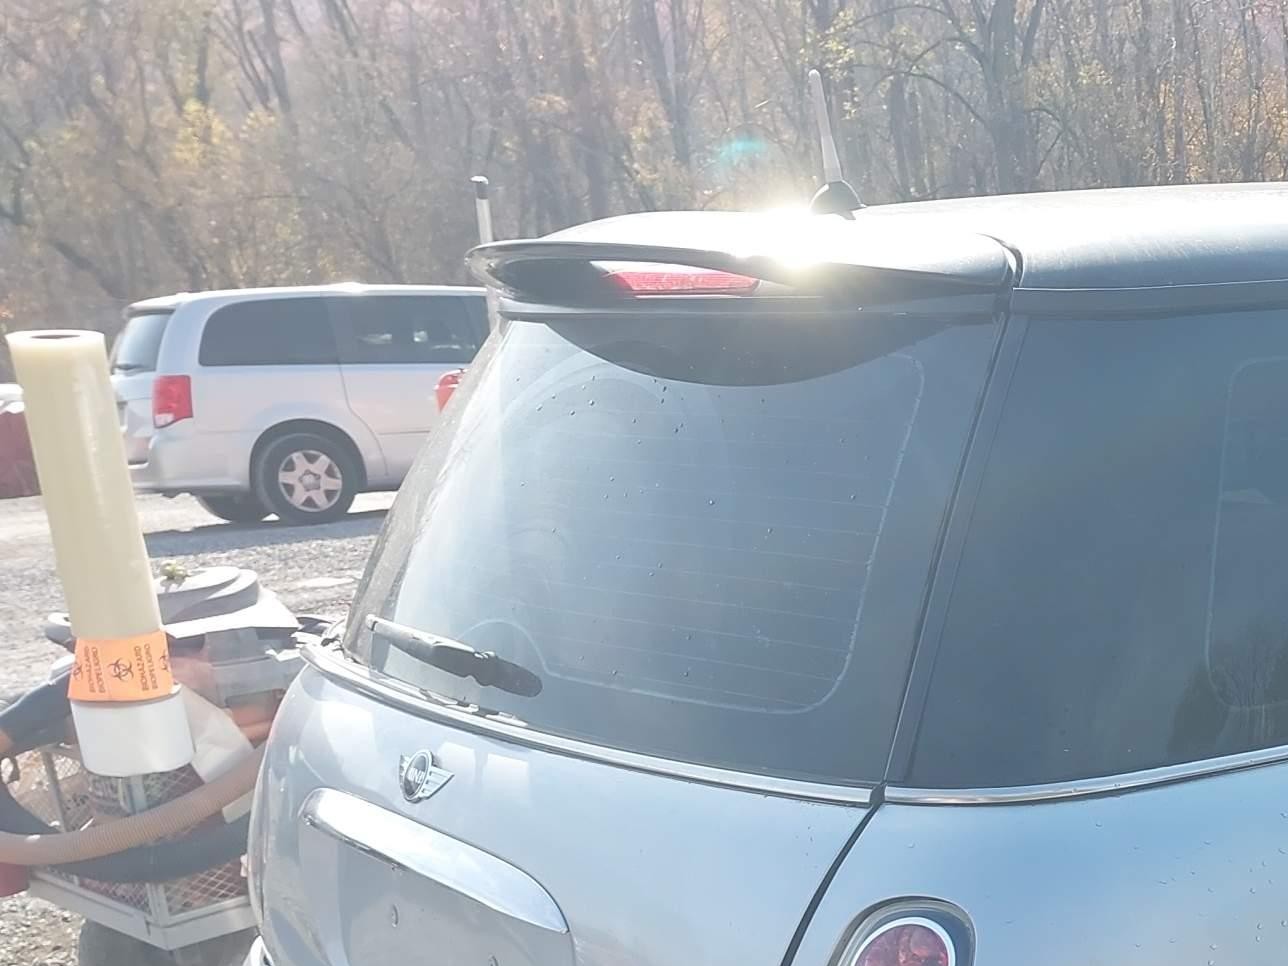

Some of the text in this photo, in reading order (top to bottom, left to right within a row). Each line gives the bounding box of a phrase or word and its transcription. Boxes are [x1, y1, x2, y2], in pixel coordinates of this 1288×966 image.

[84, 646, 96, 693] BIOHAZARD
[91, 646, 106, 693] BIOPELIGRO
[134, 645, 149, 691] BIOHAZARD
[144, 643, 158, 689] BIOPELIGRO
